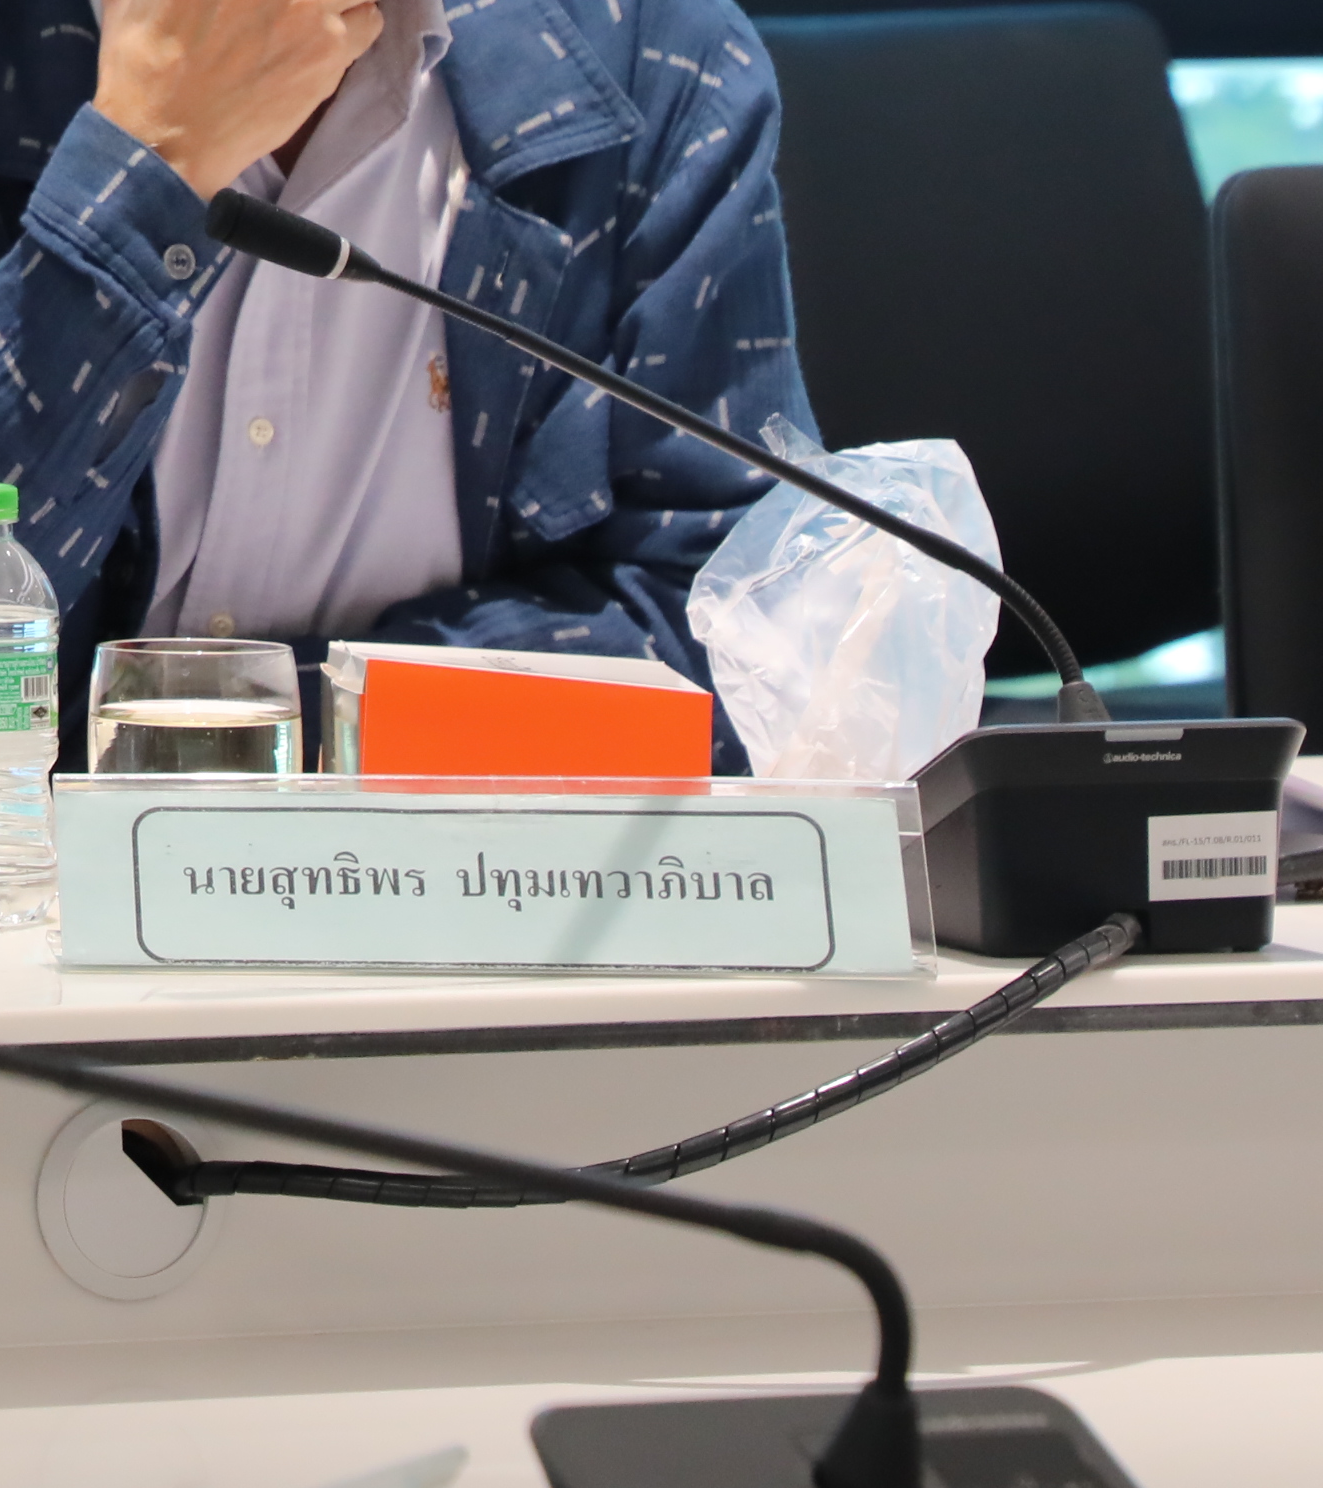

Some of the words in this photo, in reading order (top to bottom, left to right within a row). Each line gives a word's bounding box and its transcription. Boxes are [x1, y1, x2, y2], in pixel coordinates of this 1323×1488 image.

[1112, 750, 1183, 763] audio-technica
[182, 851, 426, 910] นายสุทธิพร
[455, 851, 775, 913] ปทุมเทวาภิบาล
